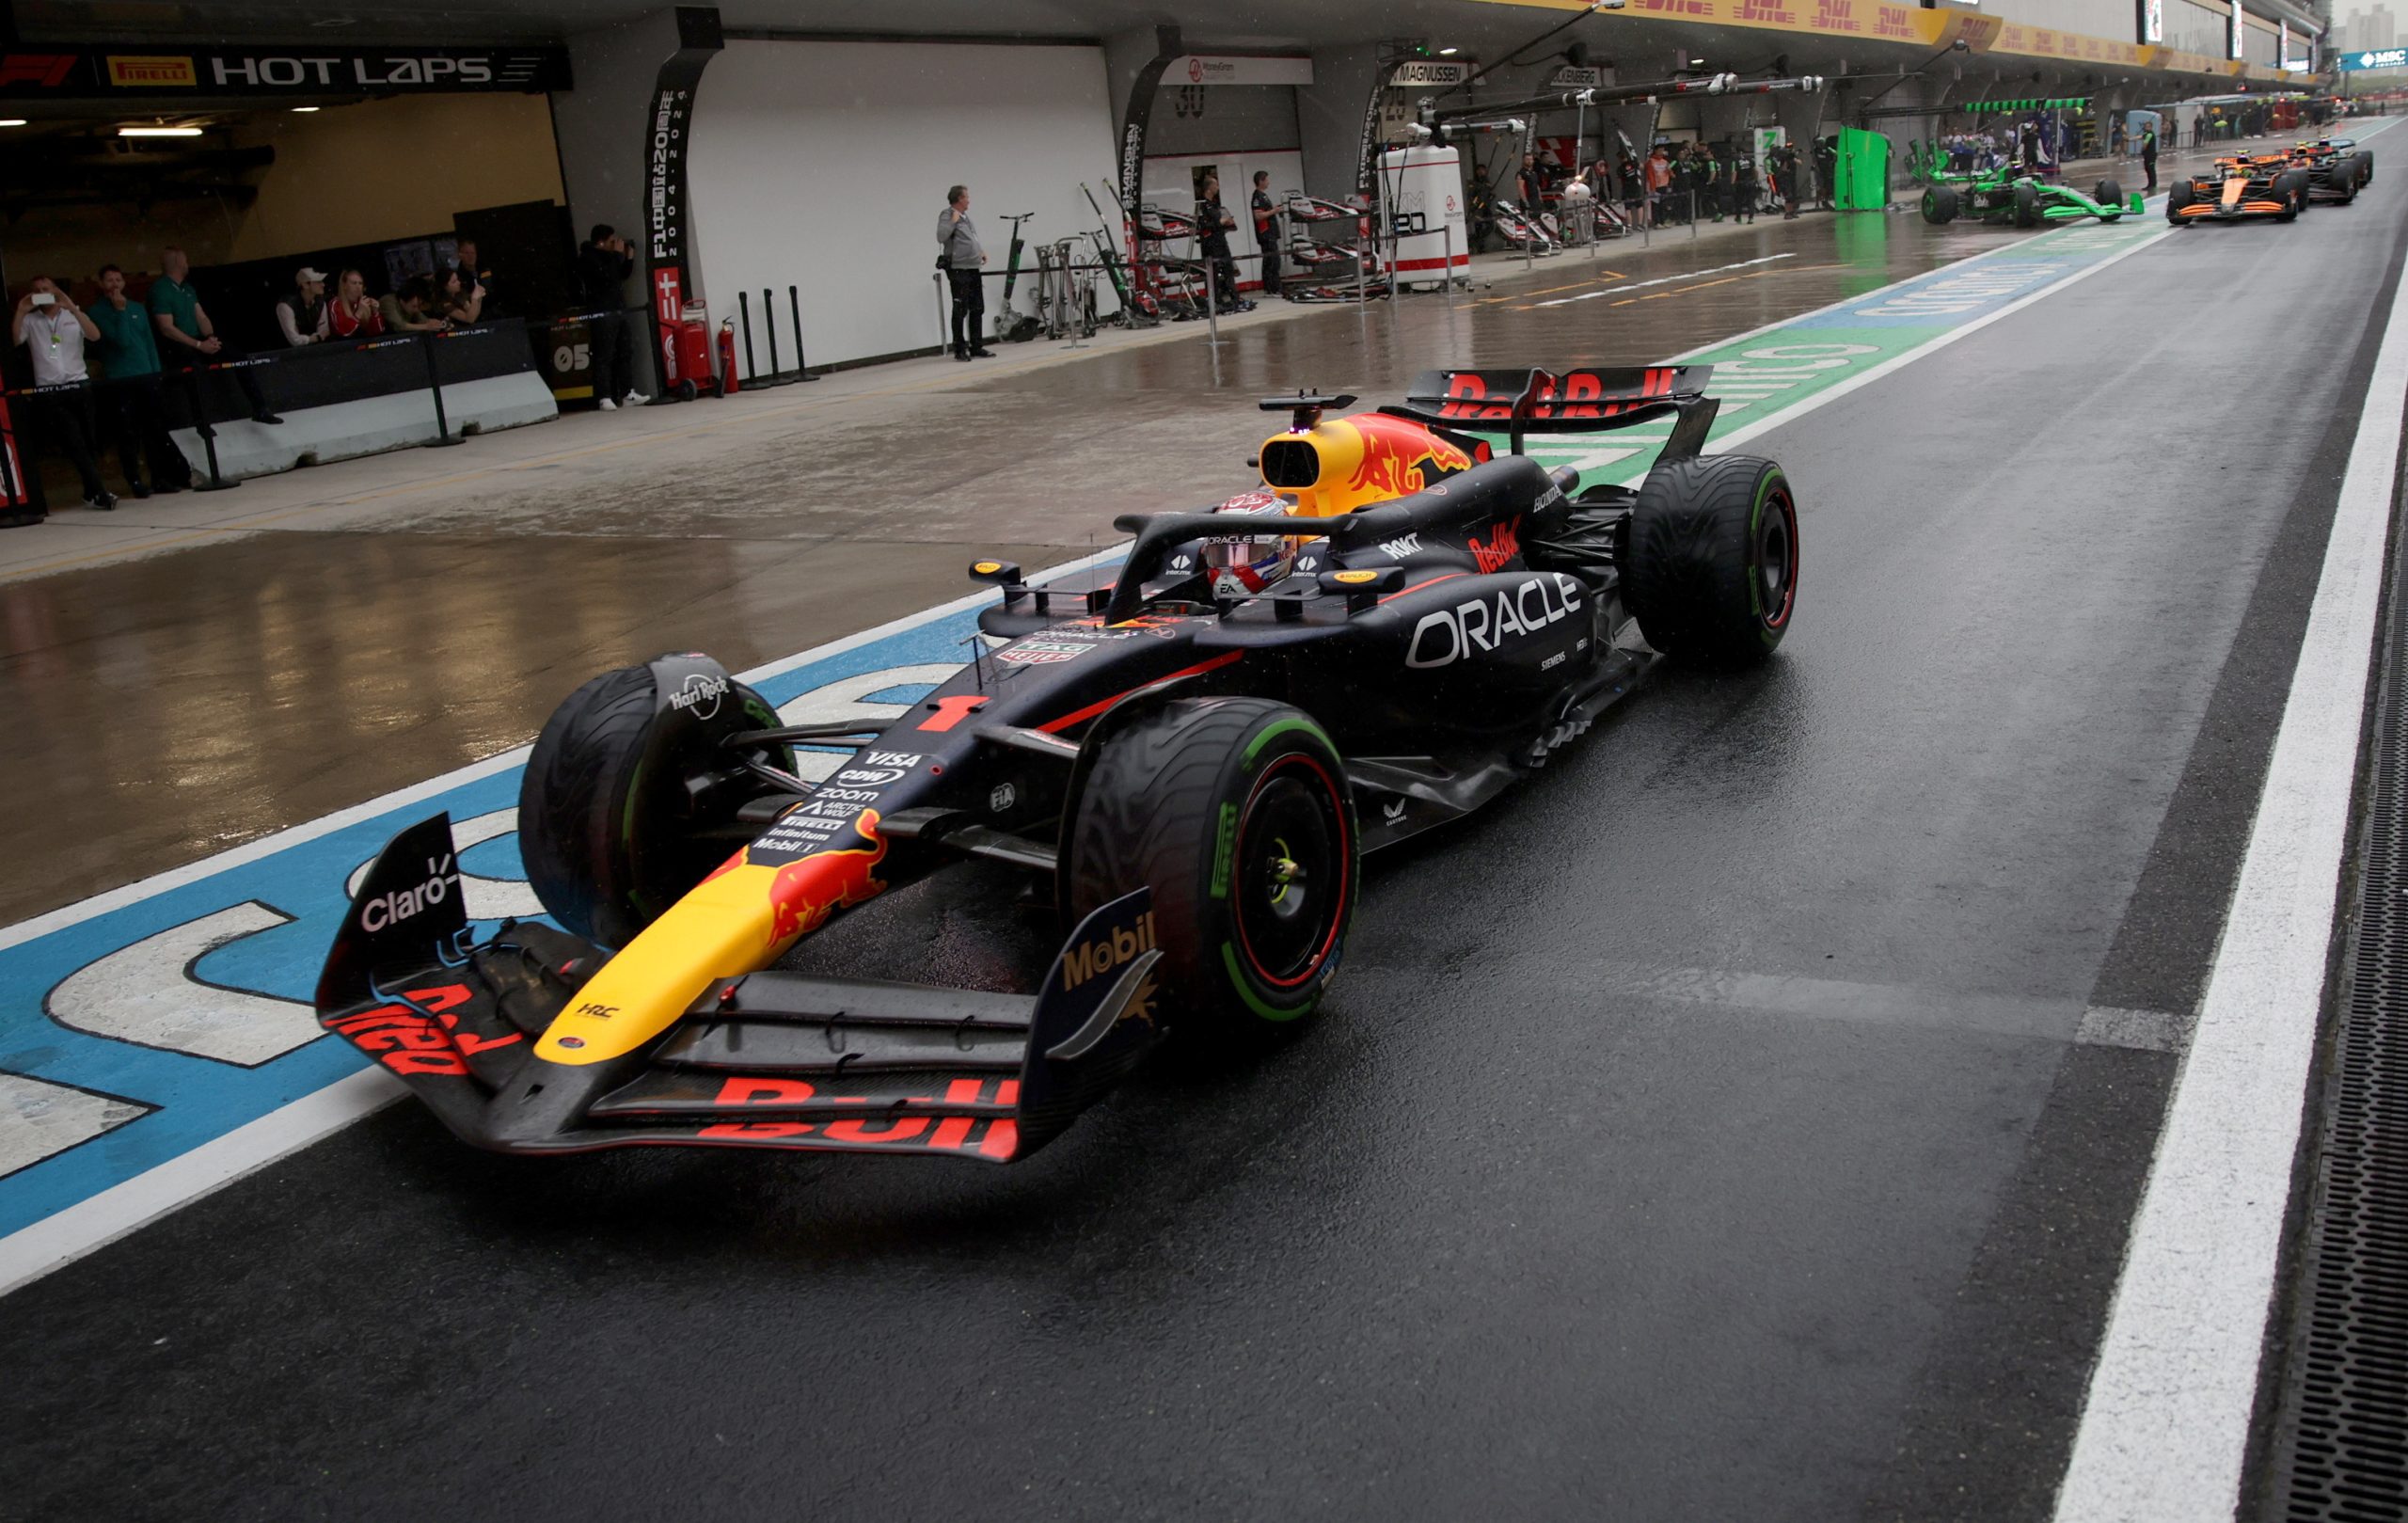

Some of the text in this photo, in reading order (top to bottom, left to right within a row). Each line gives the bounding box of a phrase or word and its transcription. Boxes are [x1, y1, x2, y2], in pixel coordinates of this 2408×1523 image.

[2375, 50, 2406, 63] MSC
[116, 62, 188, 81] PIRELLI
[212, 56, 341, 86] HOT
[355, 57, 492, 85] LAPS
[1400, 66, 1462, 82] MAGNUSSEN
[1553, 70, 1595, 84] LKENBERG
[553, 343, 591, 373] 05
[1533, 484, 1562, 513] HONDA
[1209, 535, 1252, 544] ORACLE
[1379, 531, 1424, 560] ROKT
[1220, 583, 1237, 594] EA
[1405, 572, 1581, 669] ORACLE
[1026, 643, 1085, 652] TAG
[1541, 650, 1565, 672] SIEMENS
[699, 675, 730, 701] Rock
[917, 694, 990, 732] 1
[865, 752, 923, 768] VISA
[837, 769, 890, 783] CDW
[816, 787, 879, 801] zoom
[990, 786, 1015, 809] FIA
[821, 809, 858, 817] WOLF
[823, 802, 866, 812] ARCTIC
[779, 816, 847, 831] PIRELLI
[752, 838, 800, 852] Mobil
[362, 876, 445, 932] Claro
[1063, 912, 1157, 992] Mobil
[577, 1003, 621, 1018] HRC
